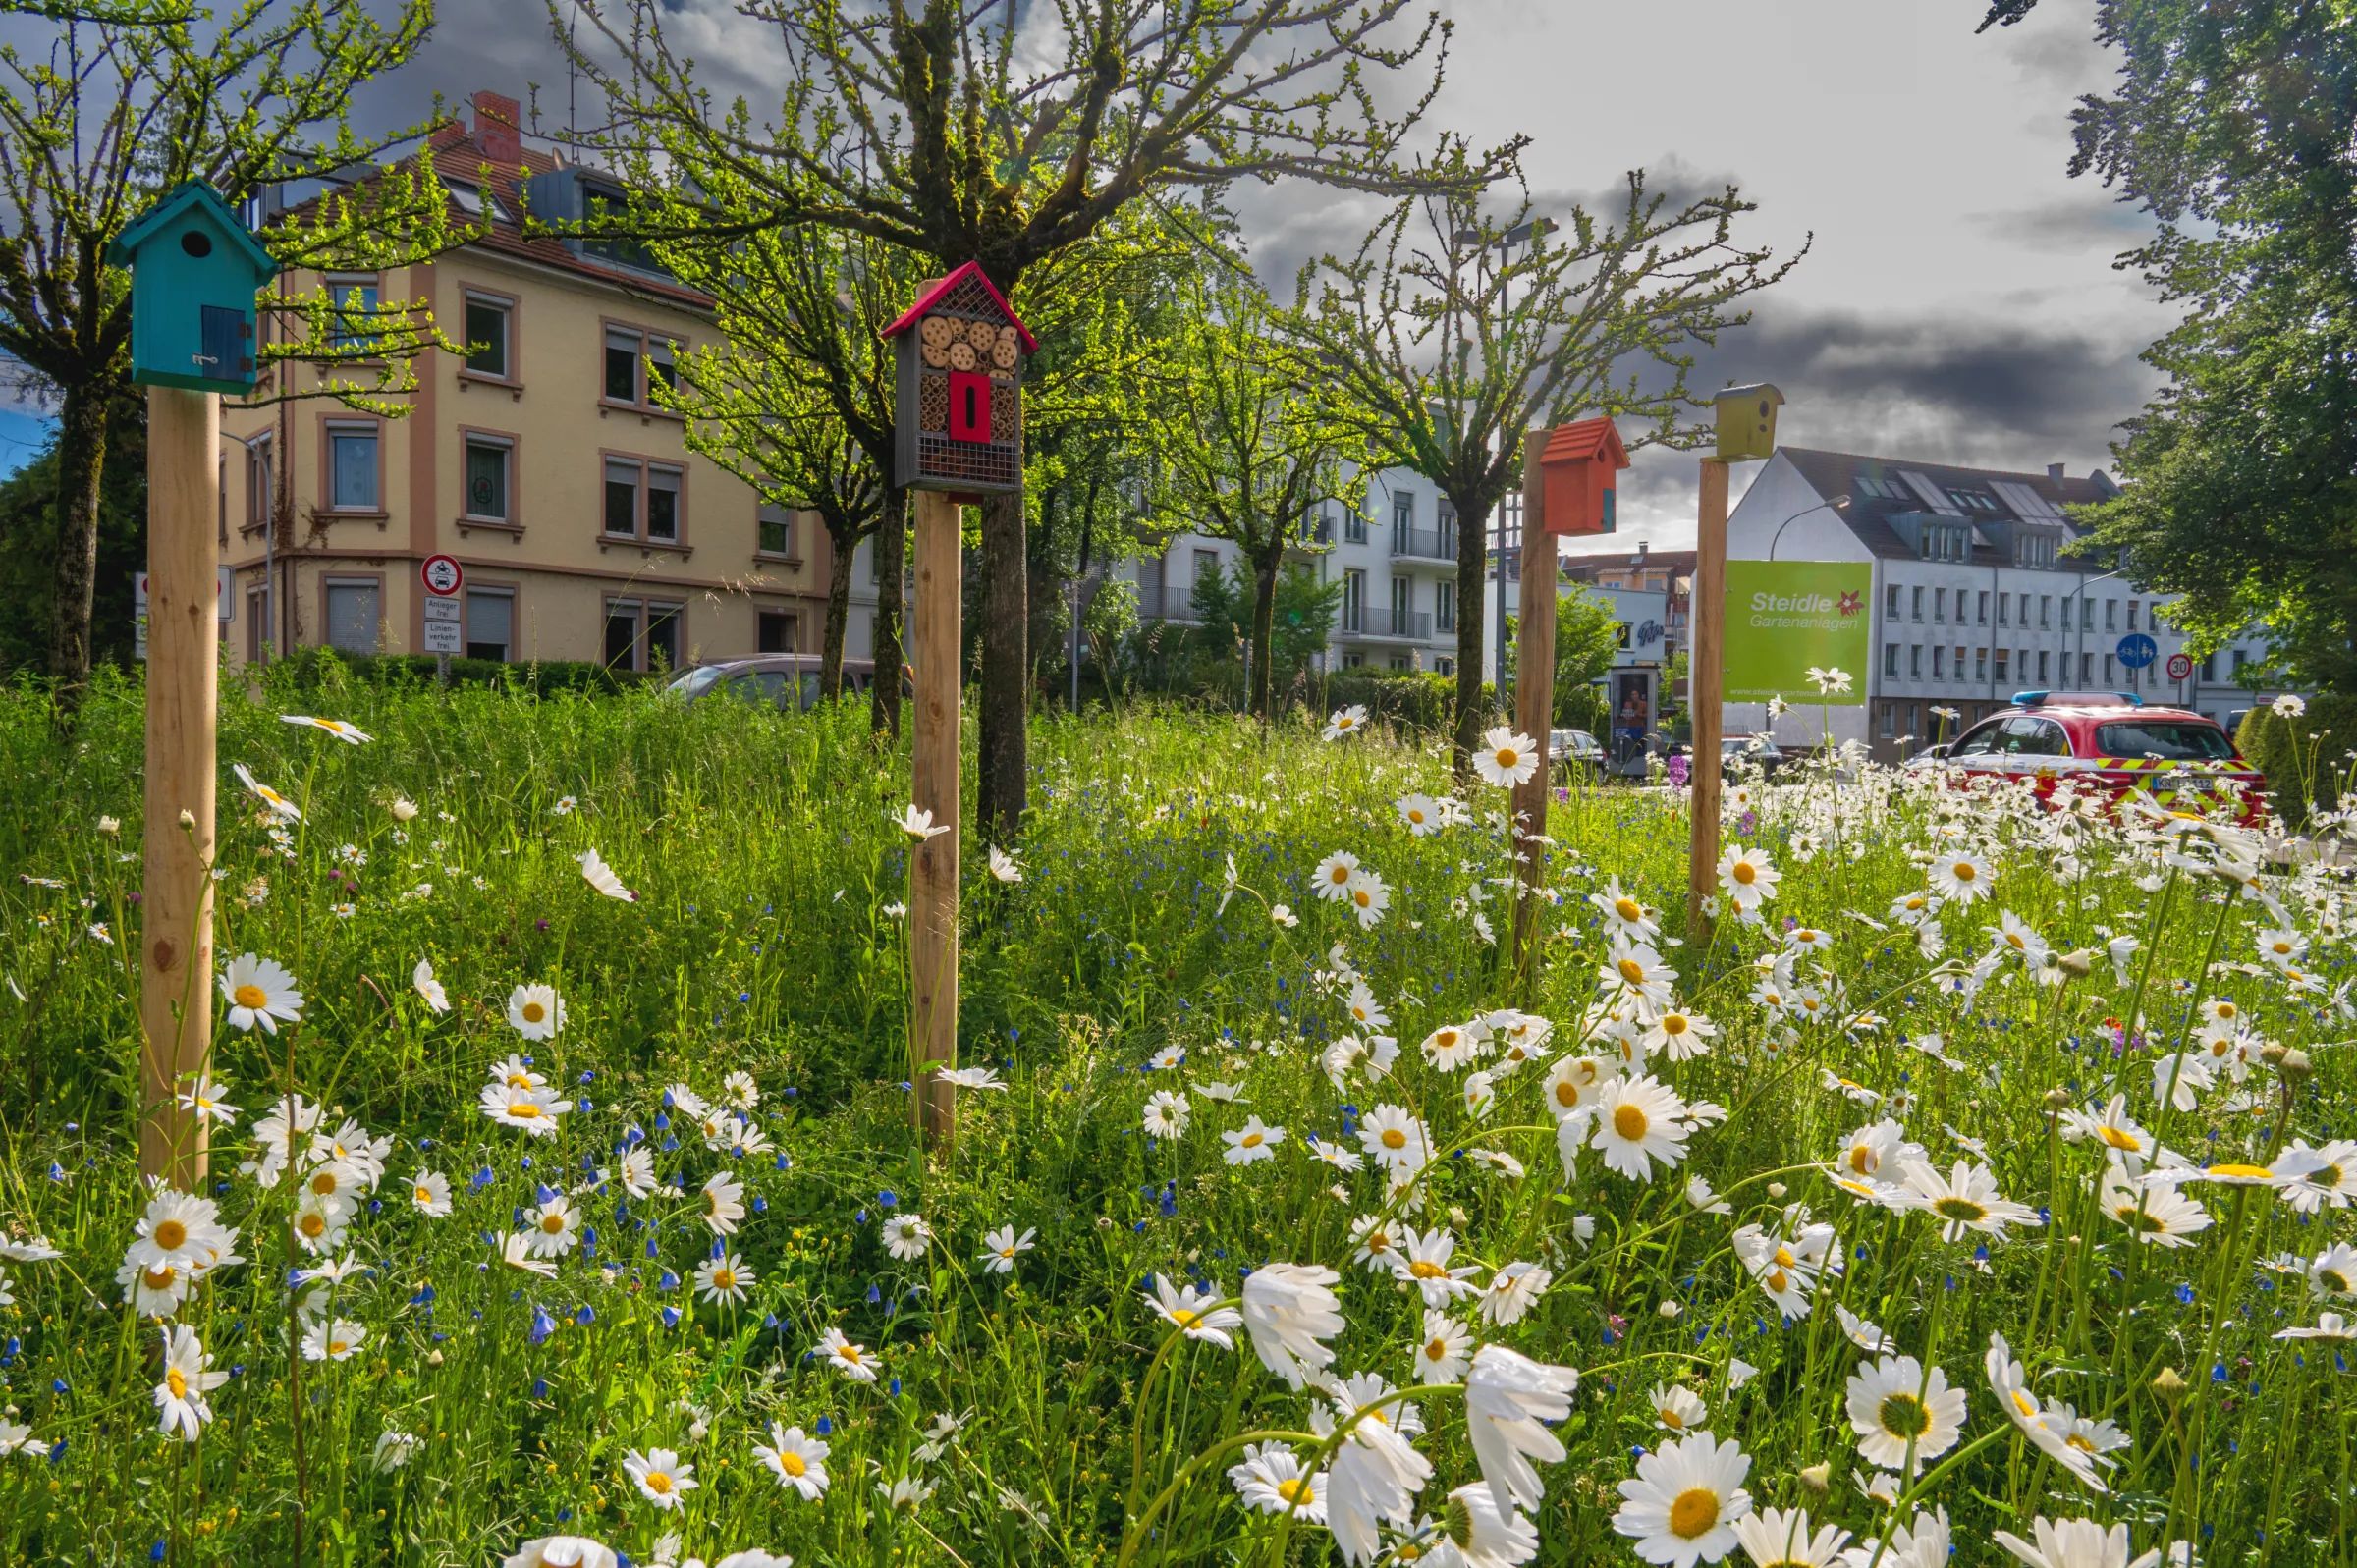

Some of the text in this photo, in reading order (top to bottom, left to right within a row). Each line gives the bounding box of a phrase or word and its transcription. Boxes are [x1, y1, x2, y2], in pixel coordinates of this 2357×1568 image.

[428, 600, 457, 610] Anlieger
[1751, 592, 1832, 612] Steidle
[1750, 614, 1858, 631] Gartenanlagen
[2172, 661, 2187, 673] 30
[1729, 687, 1855, 698] www.steidle-gartenanlgen.de
